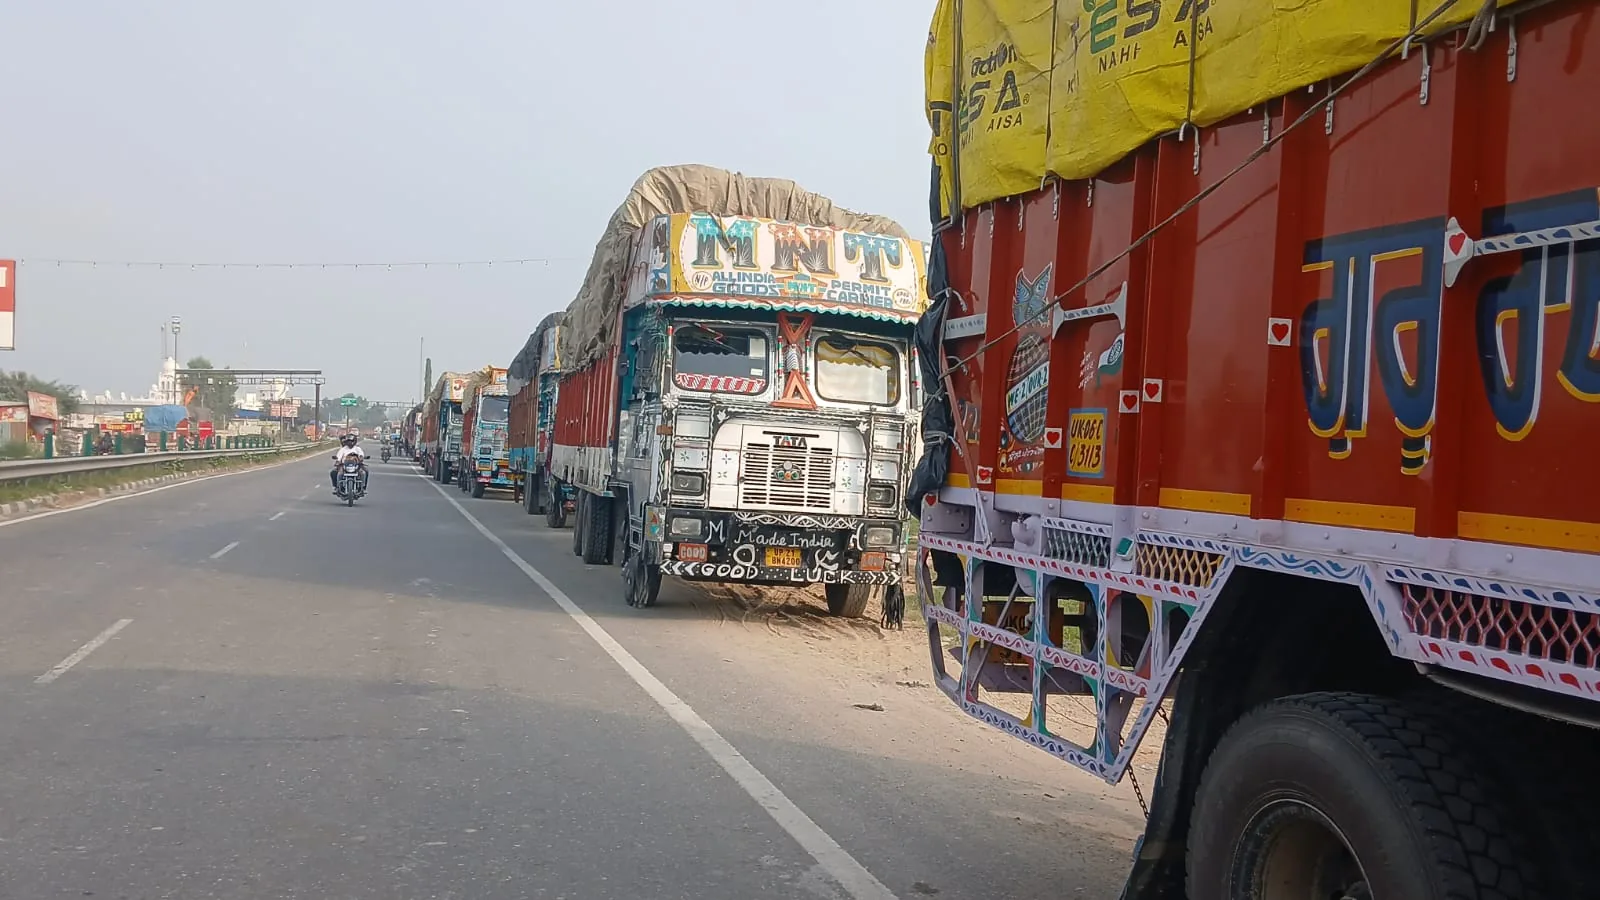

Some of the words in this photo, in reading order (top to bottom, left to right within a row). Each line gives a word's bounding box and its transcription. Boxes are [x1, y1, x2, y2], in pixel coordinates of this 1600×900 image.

[1173, 15, 1214, 49] ASA
[986, 111, 1023, 132] AISA
[712, 282, 780, 297] GOODS
[831, 280, 891, 297] PERMIT
[773, 435, 808, 448] TATA
[734, 530, 787, 546] Made
[789, 532, 834, 548] India
[701, 563, 758, 580] GOOD
[790, 567, 856, 584] LUCK
